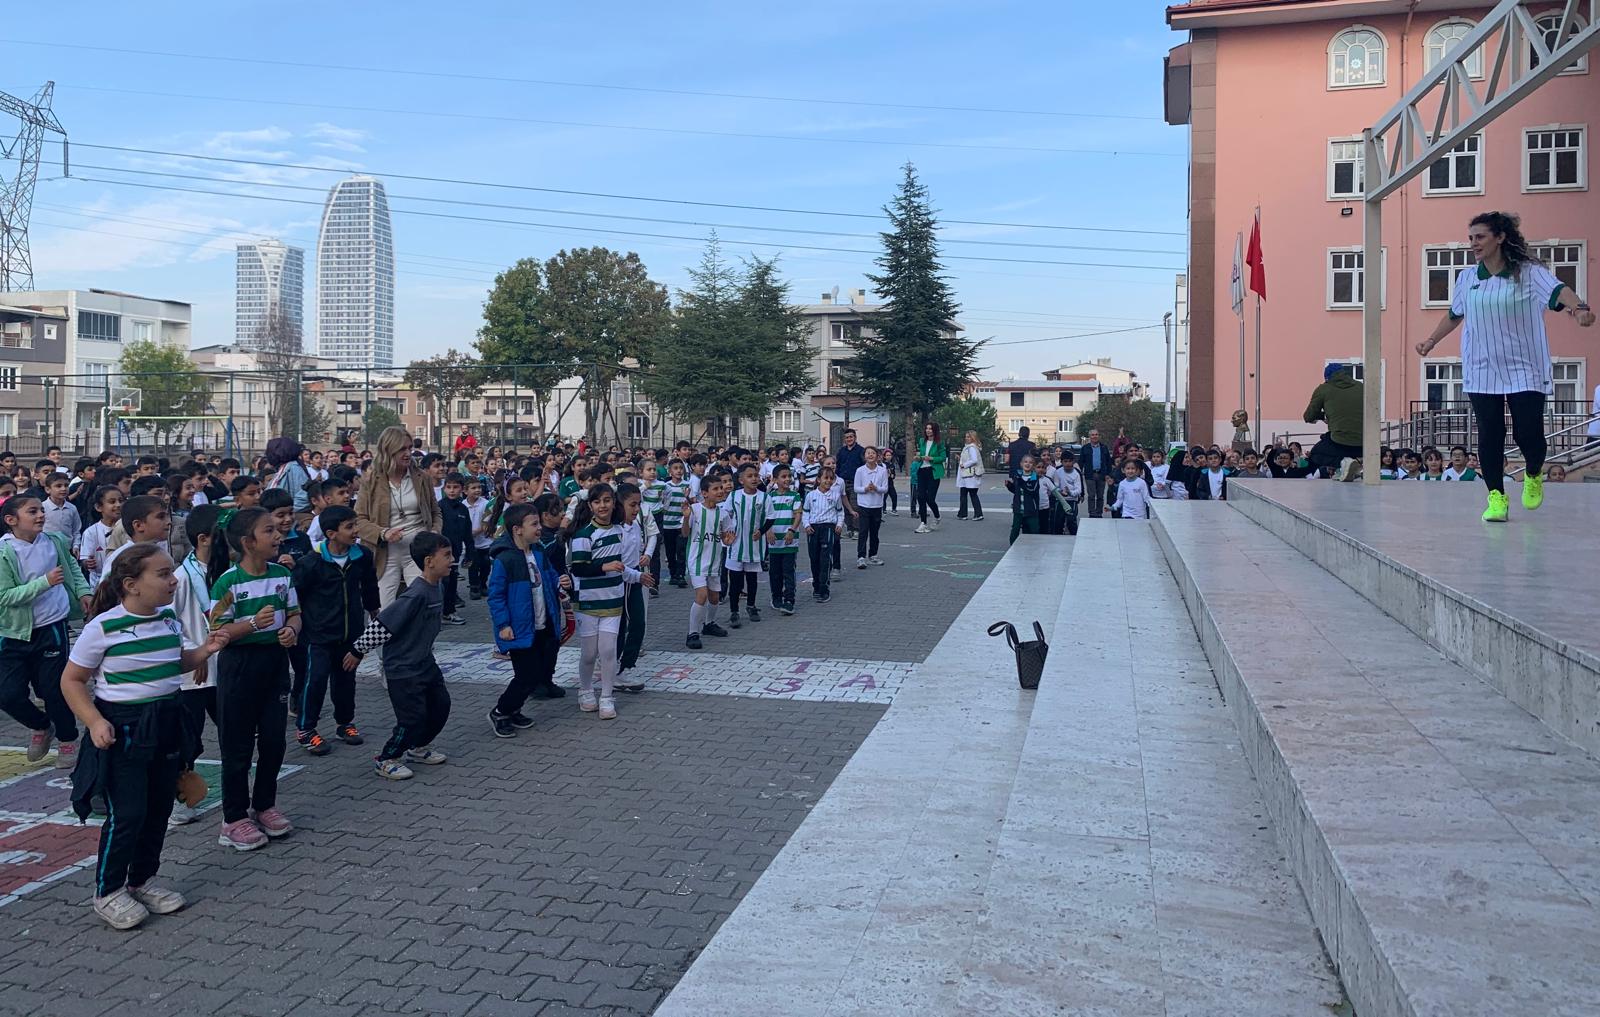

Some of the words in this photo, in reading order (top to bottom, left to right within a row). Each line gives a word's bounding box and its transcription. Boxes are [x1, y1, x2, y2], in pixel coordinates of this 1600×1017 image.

[788, 661, 812, 674] 1
[764, 677, 804, 693] 3
[838, 674, 876, 689] A
